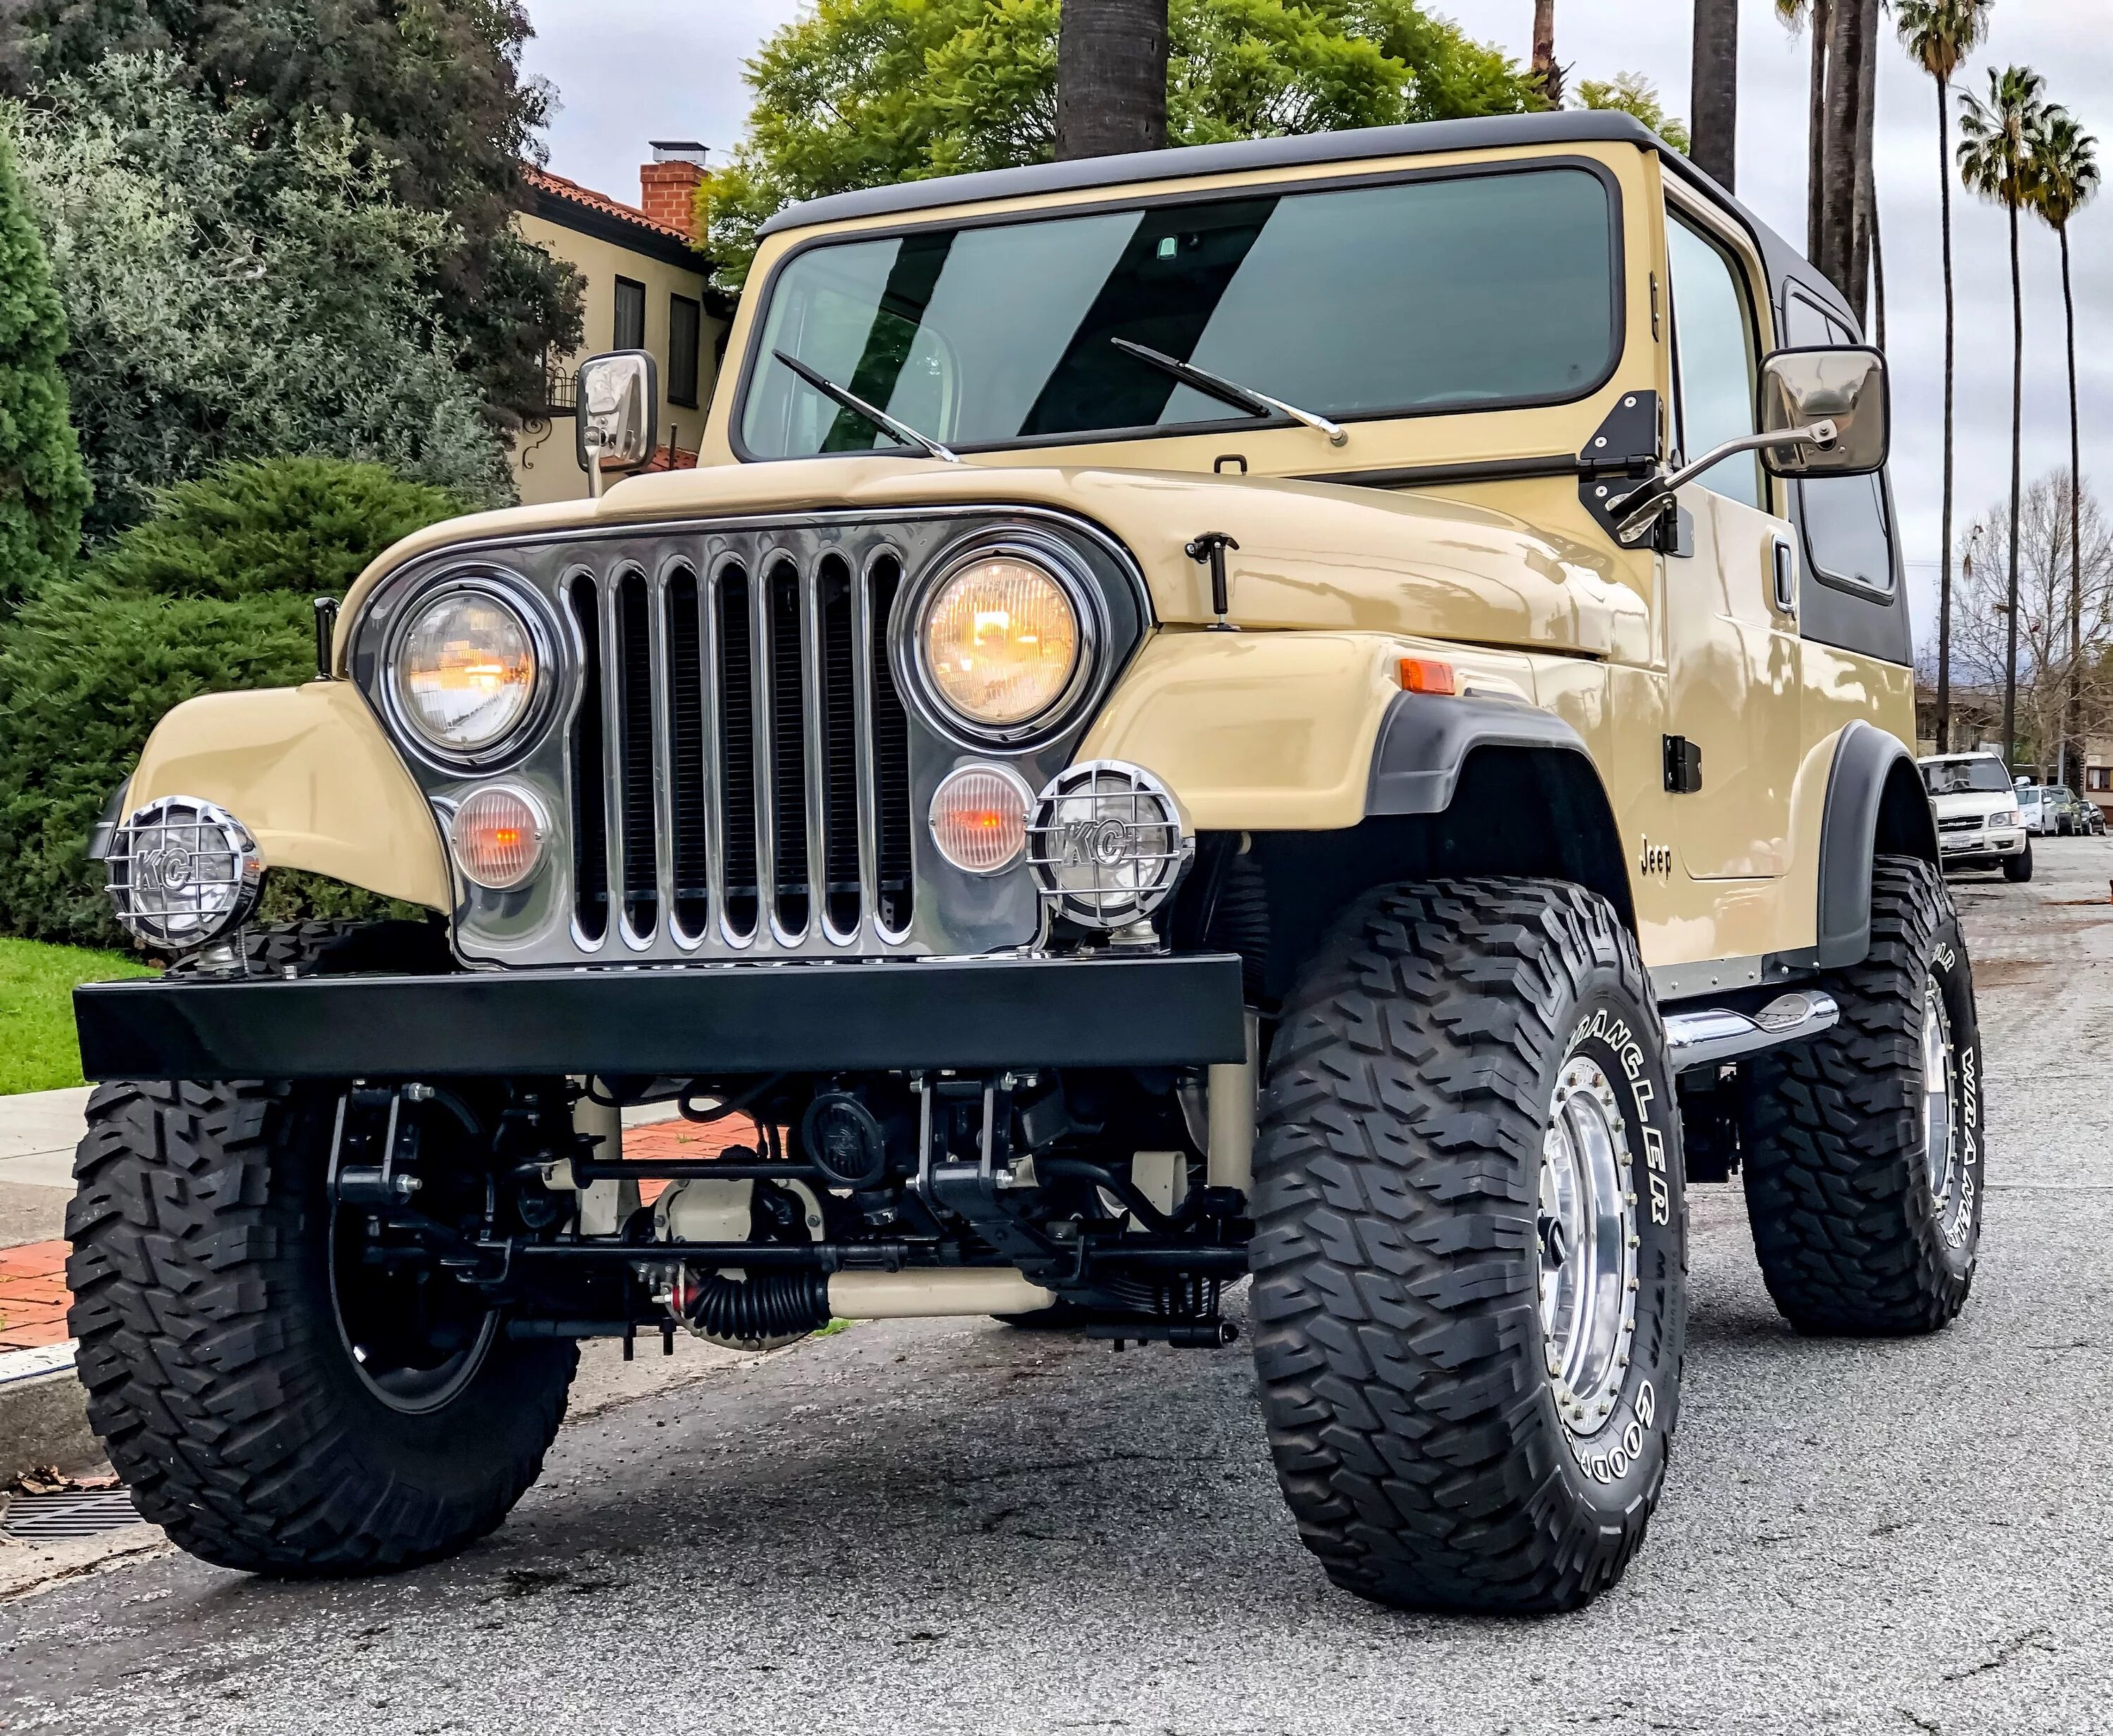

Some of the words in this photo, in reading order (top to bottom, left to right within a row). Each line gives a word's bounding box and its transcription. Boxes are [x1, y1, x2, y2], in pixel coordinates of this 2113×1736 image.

[1062, 818, 1127, 868] KC
[1639, 834, 1672, 882] Jeep
[135, 847, 192, 892] KC
[1942, 1046, 1977, 1248] WRANGLE
